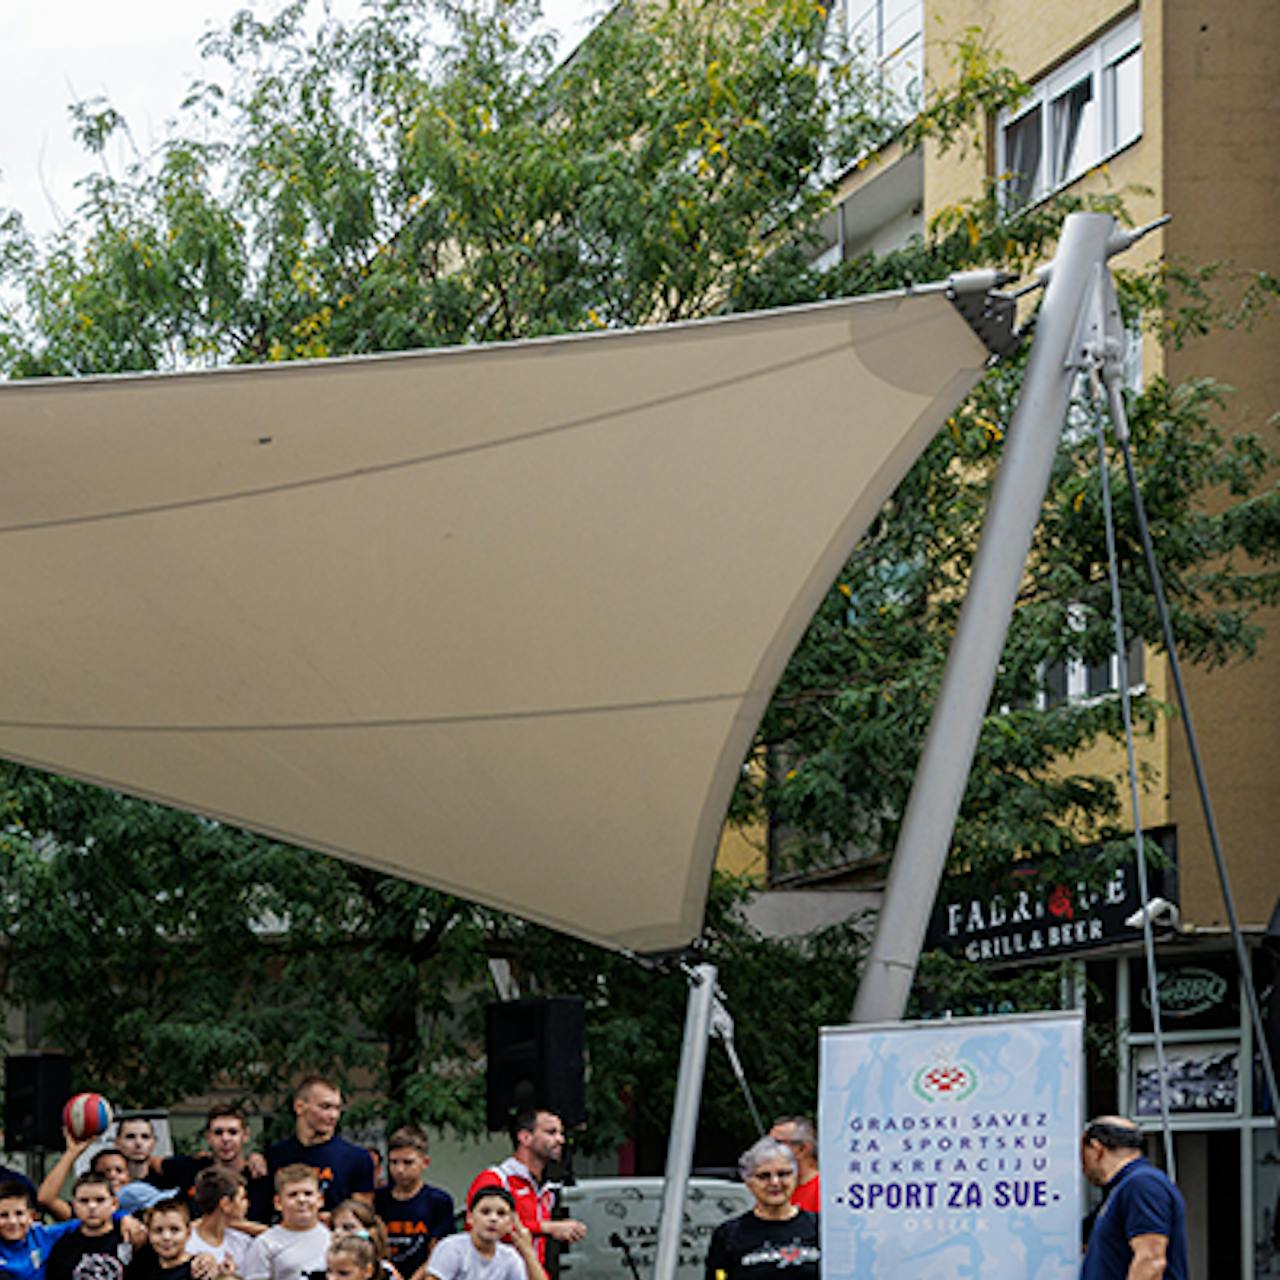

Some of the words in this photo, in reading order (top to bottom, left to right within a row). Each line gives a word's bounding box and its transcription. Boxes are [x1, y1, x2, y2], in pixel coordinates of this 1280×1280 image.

[849, 1116, 958, 1132] GRADSKI
[971, 1113, 1047, 1130] SAVEZ
[849, 1139, 880, 1152] ZA
[902, 1135, 1047, 1152] SPORTSKU
[849, 1158, 1047, 1174] REKREACIJU
[848, 1181, 938, 1209] SPORT
[947, 1181, 983, 1208] ZA
